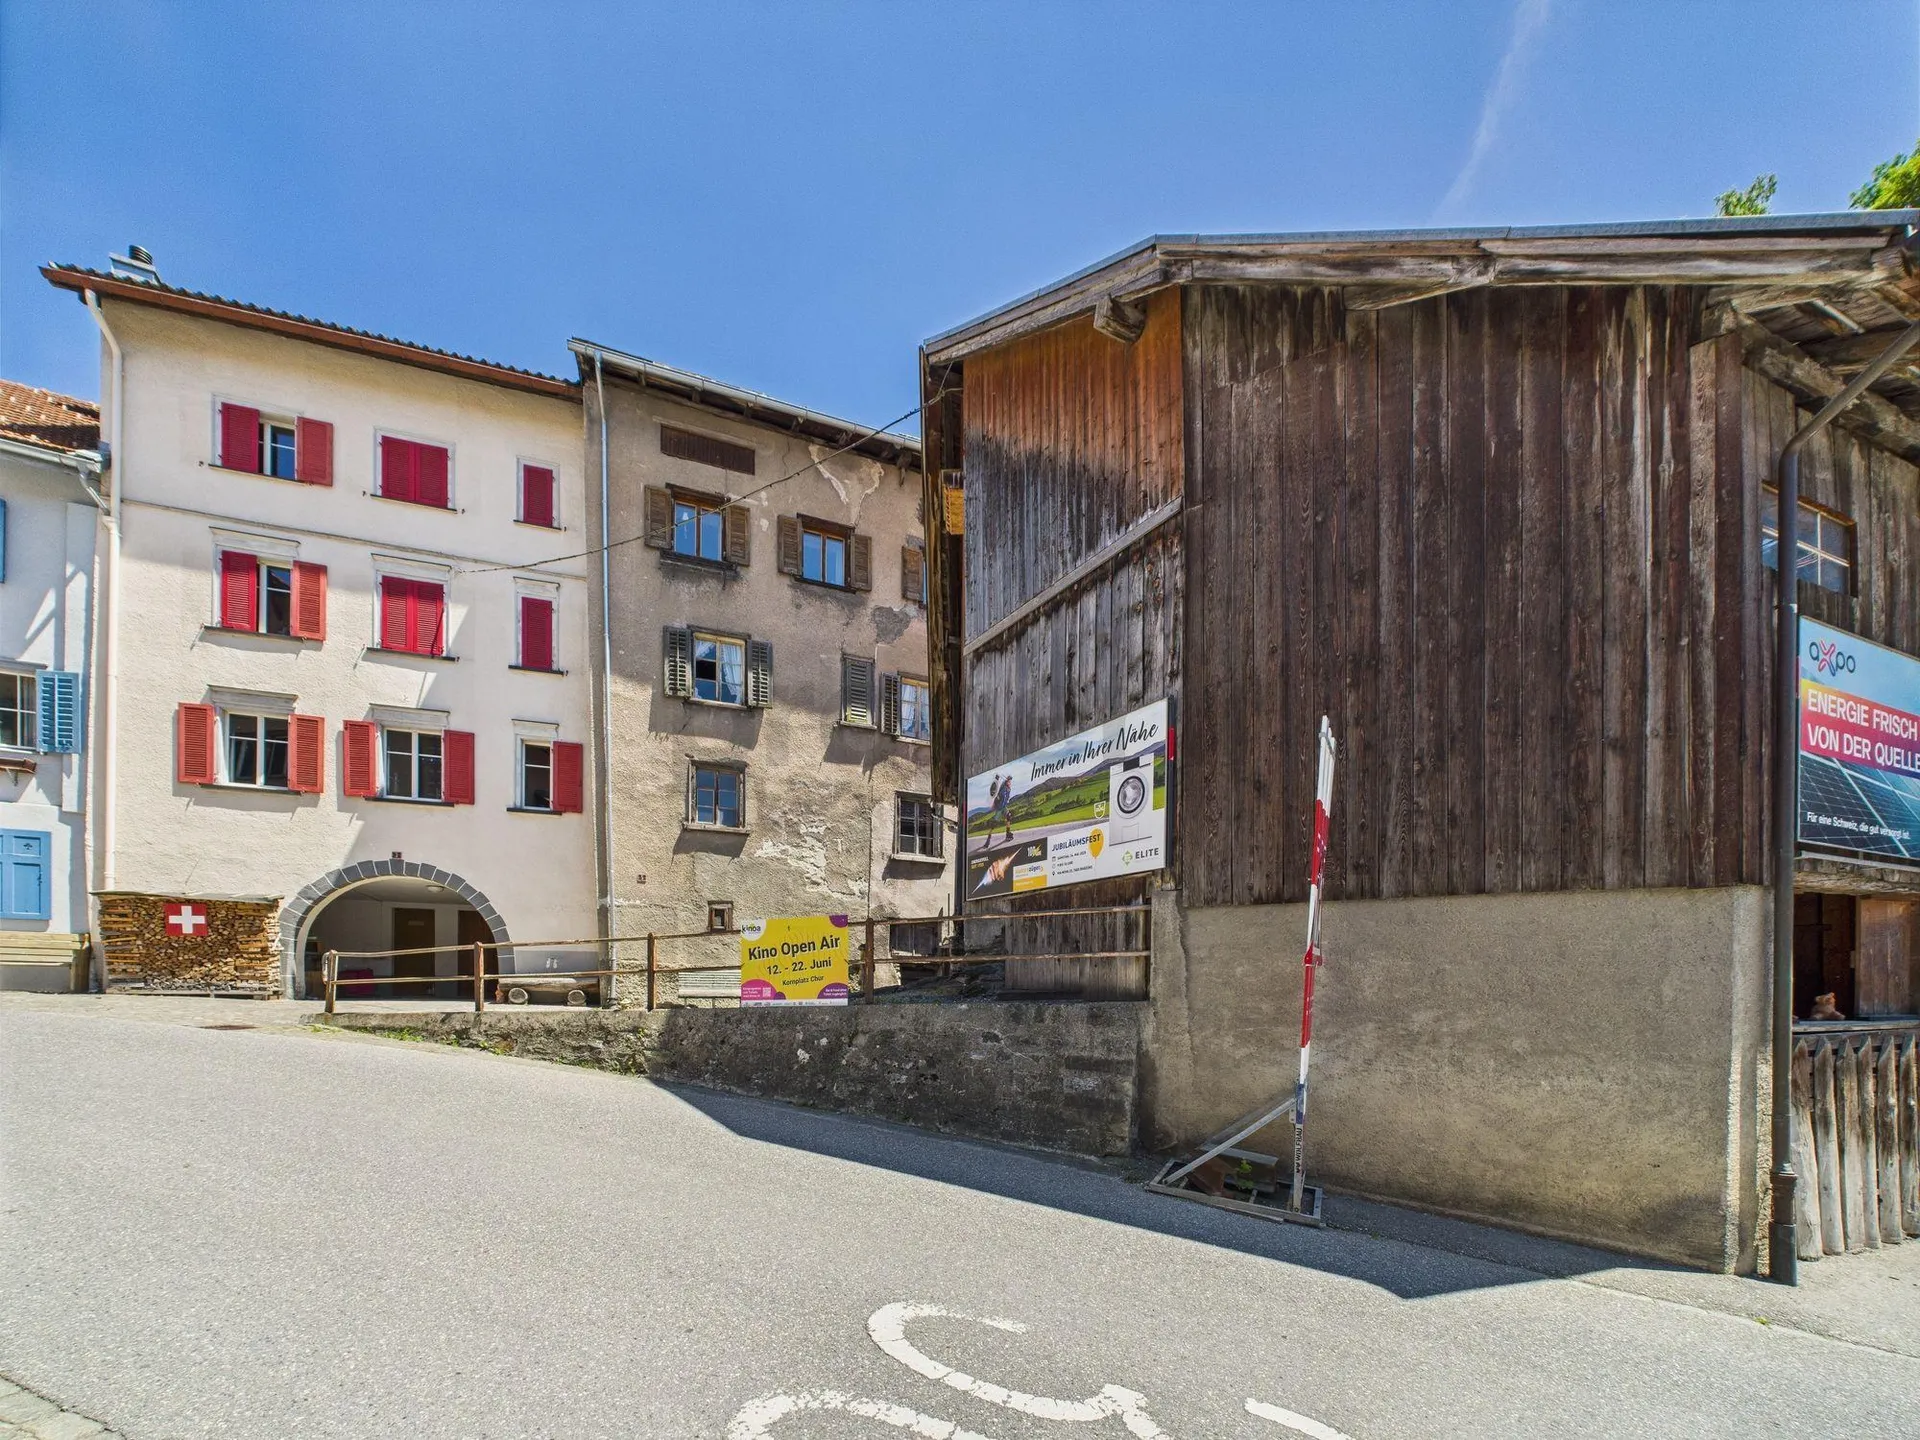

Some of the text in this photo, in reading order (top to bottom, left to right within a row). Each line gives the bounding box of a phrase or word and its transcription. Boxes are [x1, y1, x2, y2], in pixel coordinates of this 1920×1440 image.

[1809, 640, 1856, 677] axpo
[1808, 688, 1918, 742] ENERGIE FRISCH
[1030, 721, 1159, 782] Immer in Ihrer Nähe
[1807, 723, 1839, 752] VON
[1843, 734, 1871, 760] DER
[1807, 811, 1818, 823] Für
[1818, 816, 1832, 826] eine
[1833, 816, 1858, 832] Schweiz,
[1859, 822, 1869, 833] die
[1869, 824, 1879, 837] gut
[1880, 826, 1901, 840] versorgt
[1051, 833, 1101, 852] JUBILÄUMSFEST
[1135, 848, 1159, 861] ELITE
[742, 924, 761, 932] kinoa
[748, 934, 840, 960] Kino Open Air
[767, 964, 782, 975] 12.
[792, 961, 807, 972] 22.
[810, 956, 832, 969] Juni
[782, 974, 824, 986] Kornplatz Chur
